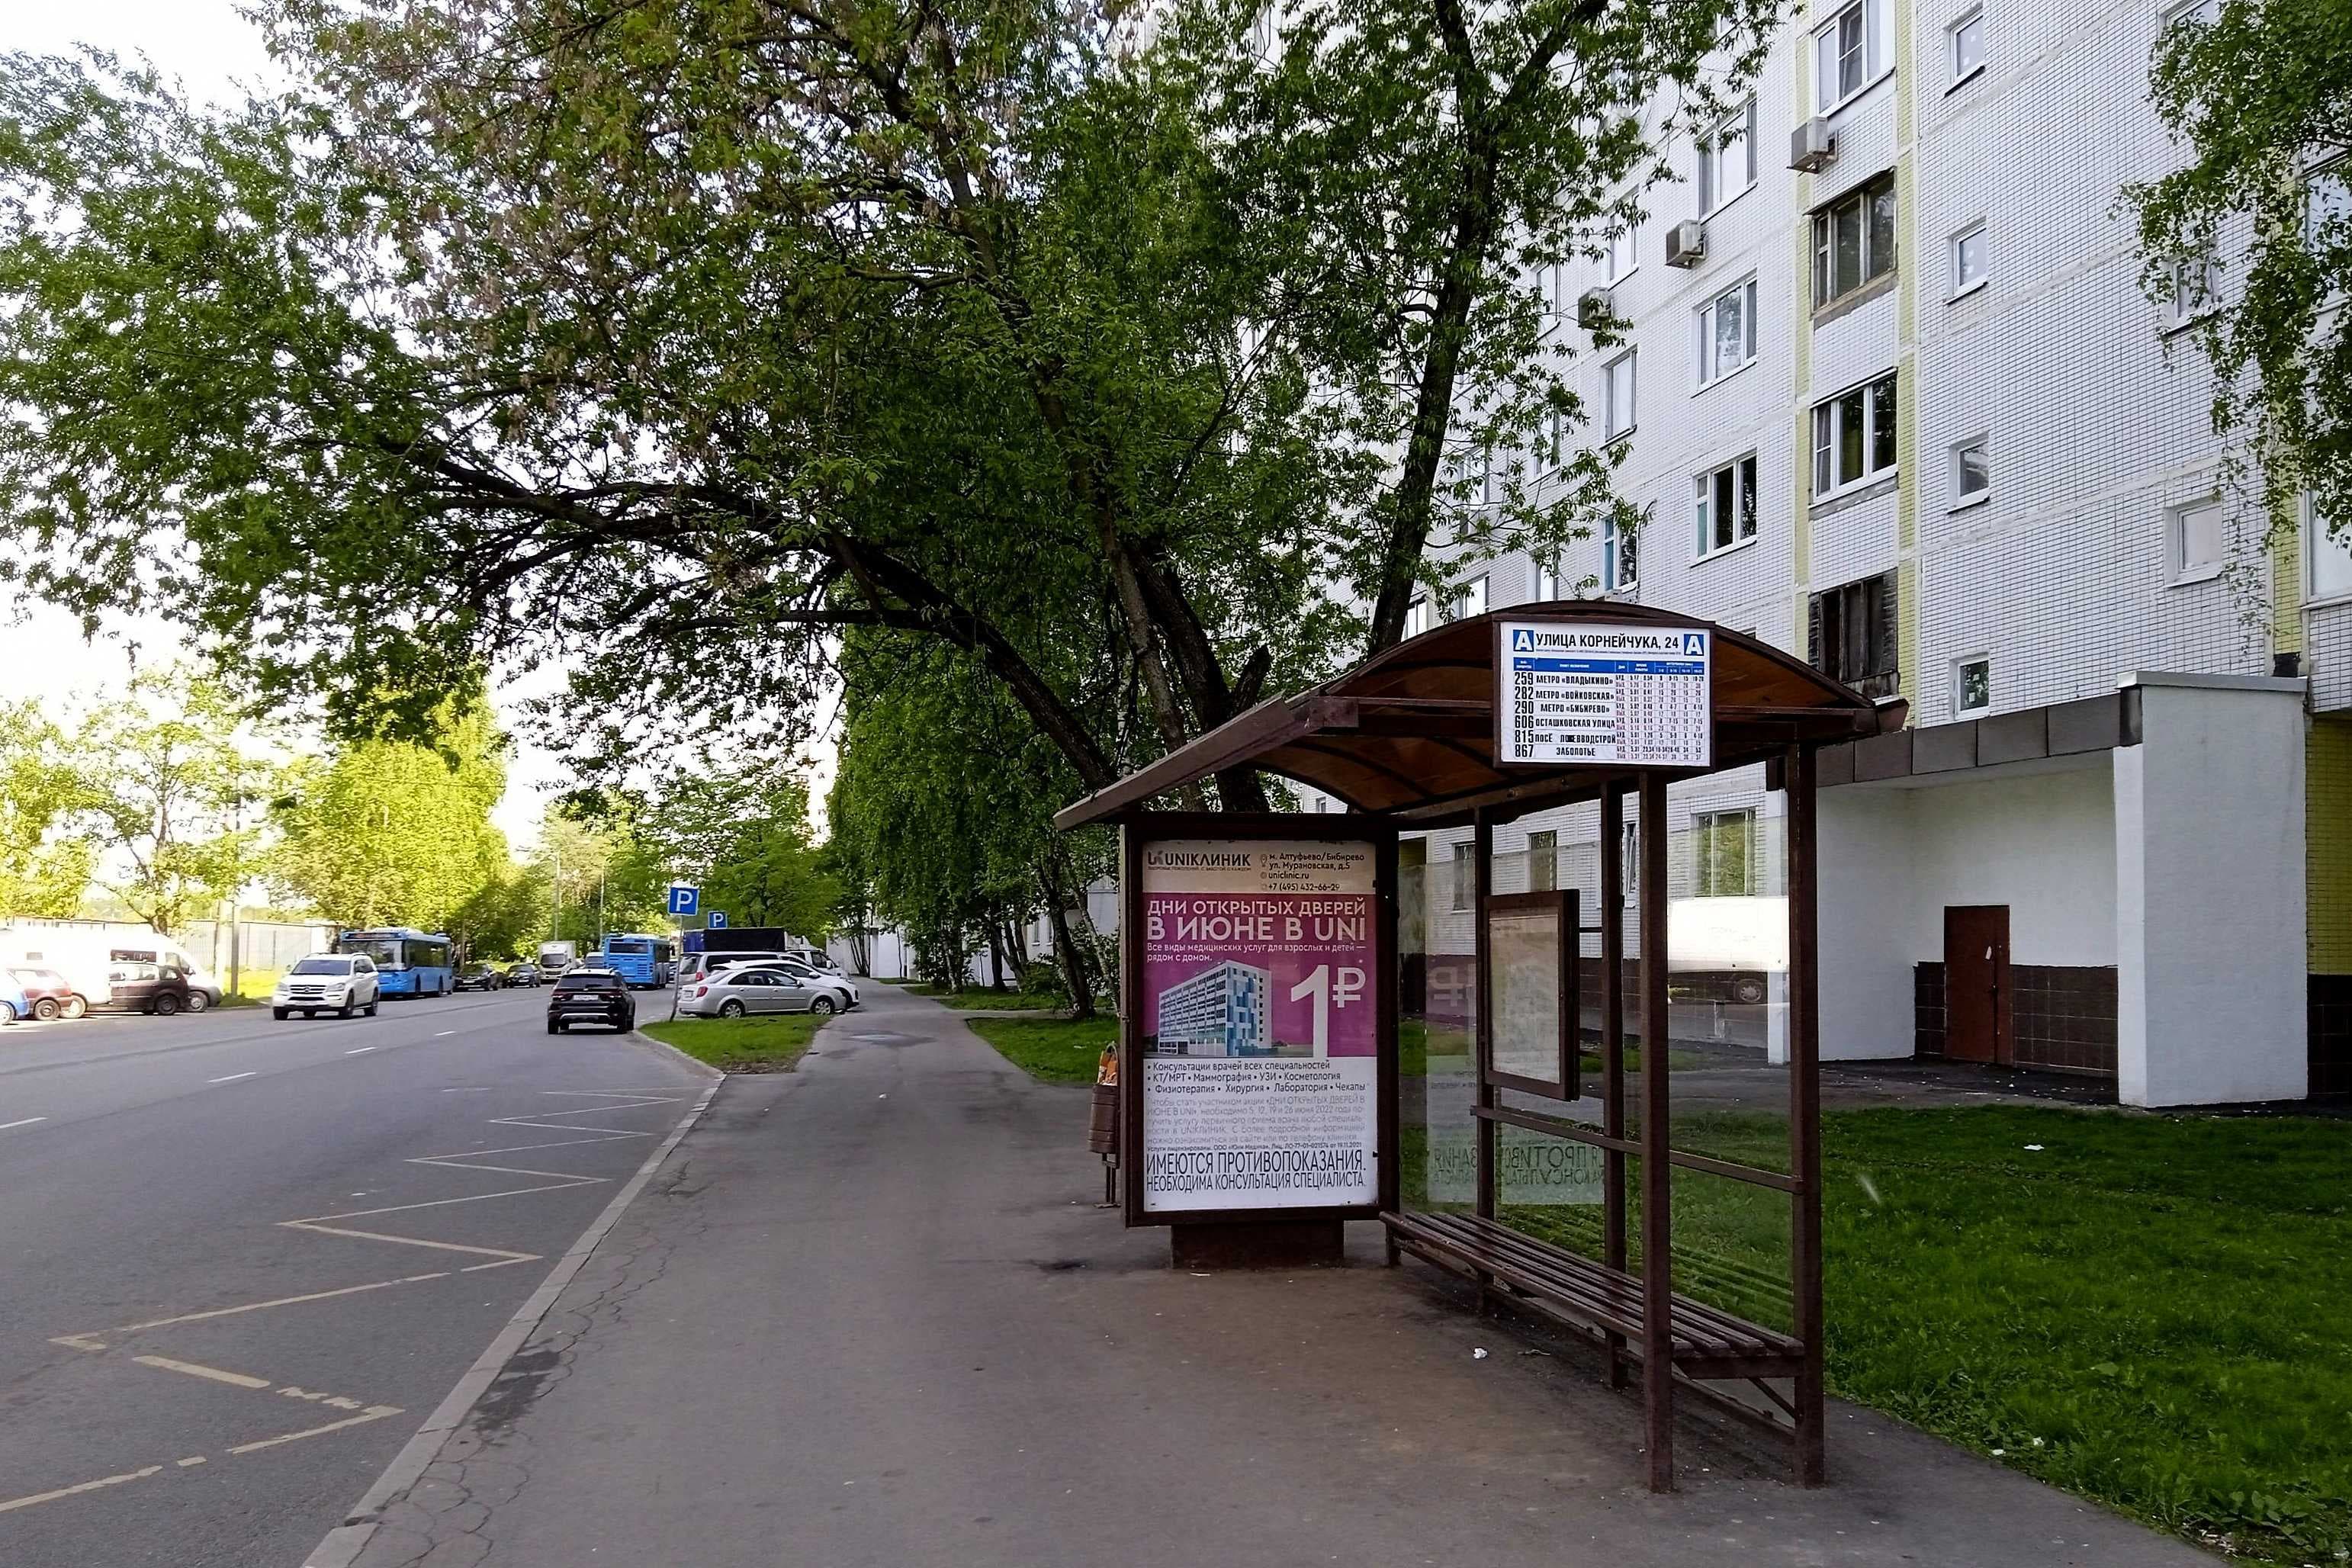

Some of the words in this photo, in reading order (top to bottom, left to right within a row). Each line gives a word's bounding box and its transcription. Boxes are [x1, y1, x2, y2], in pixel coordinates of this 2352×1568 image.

[1536, 633, 1576, 648] УЛИЦА
[1579, 632, 1661, 650] КОРНЕЙЧУКА,
[1665, 636, 1679, 648] 24
[1515, 672, 1534, 685] 259
[1536, 675, 1560, 683] МЕТРО
[1561, 676, 1613, 685] «ВЛАДЫКИНО»
[1515, 686, 1534, 699] 282
[1536, 690, 1559, 699] МЕТРО
[1561, 690, 1615, 700] «ВОЙКОВСКАЯ»
[1515, 700, 1534, 714] 290
[1541, 703, 1564, 712] МЕТРО
[1566, 704, 1610, 713] «БИБИРЕВО»
[1515, 715, 1534, 728] 606
[1535, 718, 1591, 728] ОСТАШКОВСКАЯ
[1592, 719, 1615, 729] УЛИЦА
[1515, 730, 1534, 743] 815
[1515, 744, 1534, 757] 867
[1556, 747, 1595, 756] ЗАБОЛОТЬЕ
[1283, 862, 1337, 870] Мурановская,
[1268, 871, 1309, 879] uniclinic.ru
[1279, 882, 1298, 892] (495)
[676, 890, 693, 911] P
[1148, 901, 1187, 916] ДНИ
[1193, 901, 1294, 915] ОТКРЫТЫХ
[1299, 897, 1366, 917] ДВЕРЕЙ
[713, 913, 724, 927] P
[1147, 917, 1166, 940] В
[1177, 917, 1274, 941] ИЮНЕ
[1286, 917, 1303, 940] В
[1314, 917, 1366, 941] UNI
[1147, 943, 1162, 951] Все
[1165, 944, 1186, 953] виды
[1187, 944, 1242, 953] медицинских
[1245, 944, 1265, 953] услуг
[1268, 944, 1283, 953] для
[1284, 944, 1323, 953] взрослых
[1332, 942, 1354, 953] детей
[1147, 954, 1174, 962] рядом
[1153, 1062, 1211, 1072] Консультации
[1213, 1060, 1242, 1072] врачей
[1264, 1059, 1330, 1071] специальностей
[1153, 1072, 1187, 1083] КТ/МРТ
[1194, 1072, 1252, 1083] Маммография
[1259, 1072, 1277, 1081] УЗИ
[1284, 1072, 1341, 1081] Косметология
[1155, 1084, 1216, 1095] Физиотерапия
[1226, 1084, 1264, 1094] Хирургия
[1274, 1082, 1328, 1094] Лаборатория
[1147, 1152, 1213, 1174] ИМЕЮТСЯ
[1218, 1149, 1366, 1173] ПРОТИВОПОКАЗАНИЯ.
[1147, 1175, 1213, 1194] НЕОБХОДИМА
[1215, 1172, 1290, 1191] КОНСУЛЬТАЦИЯ
[1293, 1171, 1367, 1191] СПЕЦИАЛИСТА.
